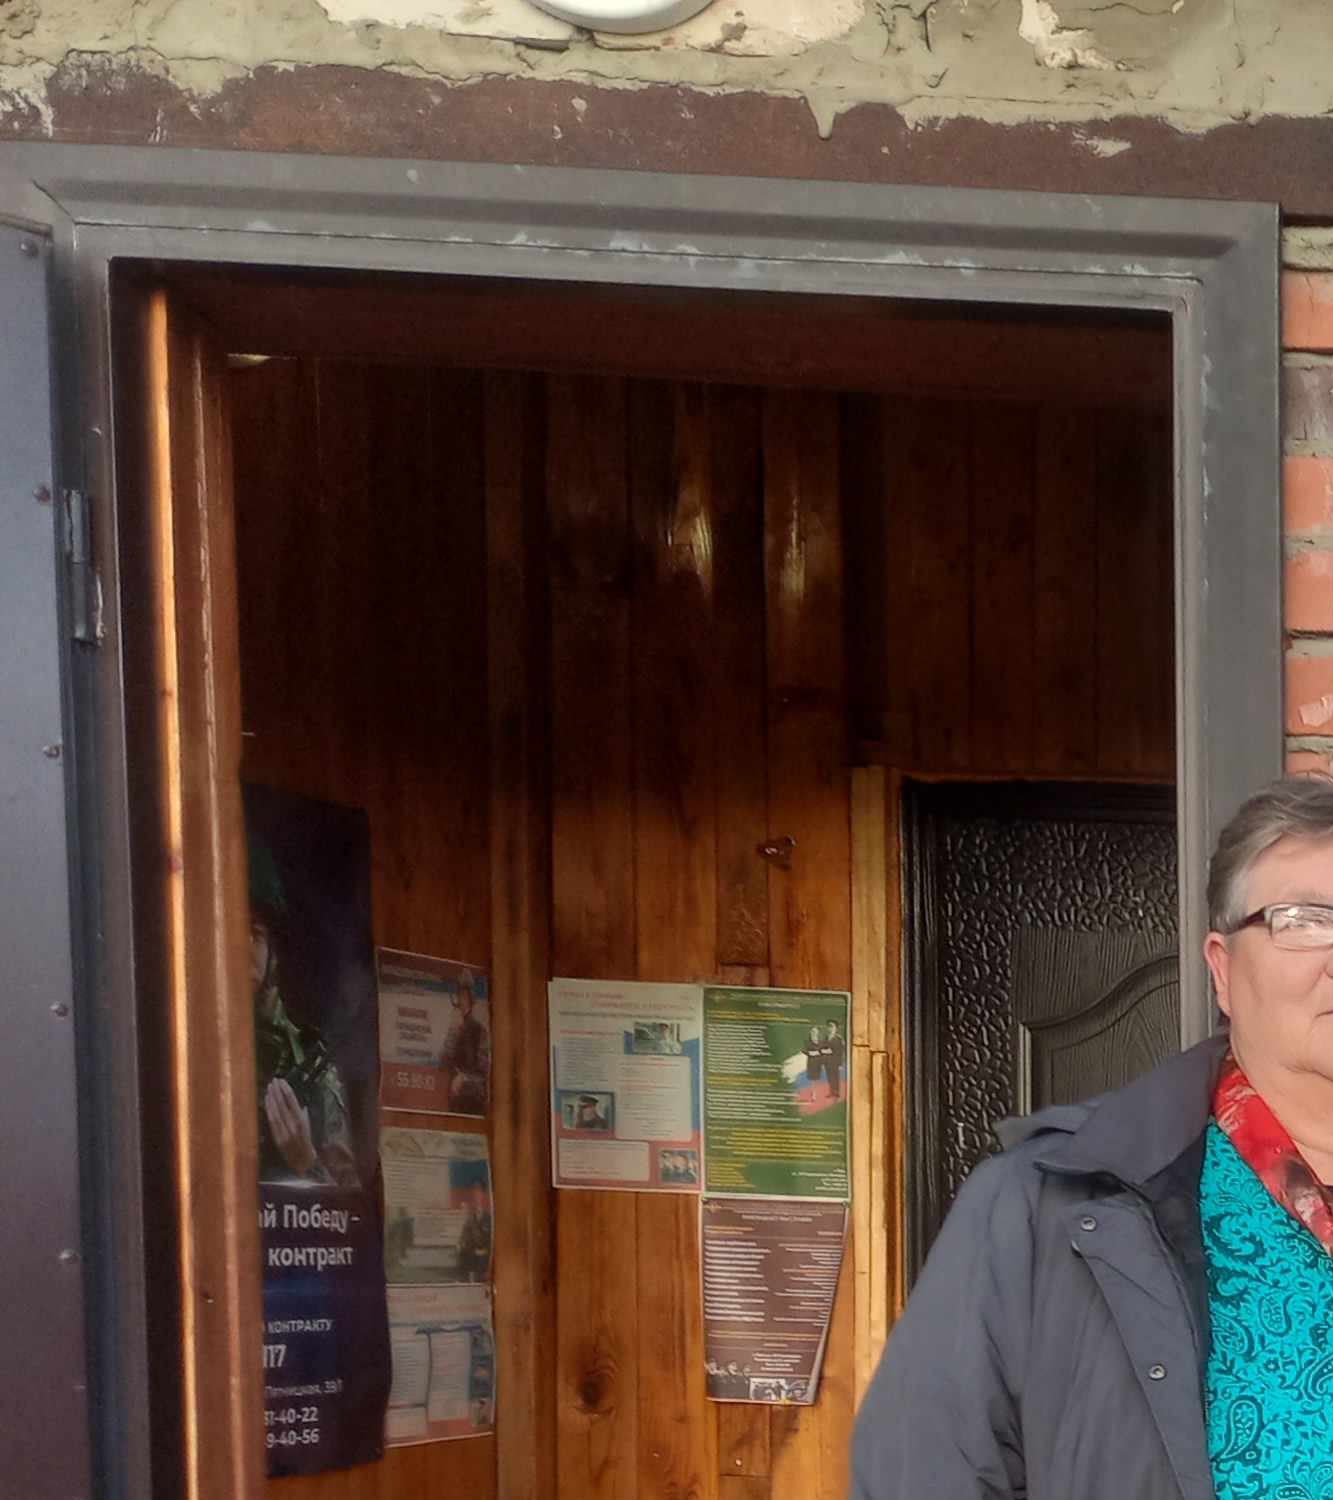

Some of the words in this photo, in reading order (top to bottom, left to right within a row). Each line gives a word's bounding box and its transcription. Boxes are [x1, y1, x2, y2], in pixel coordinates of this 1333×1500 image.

[283, 1203, 348, 1234] Победу
[268, 1246, 353, 1271] контракт
[268, 1318, 332, 1333] КОНТРАКТУ
[265, 1428, 320, 1448] 9-40-56
